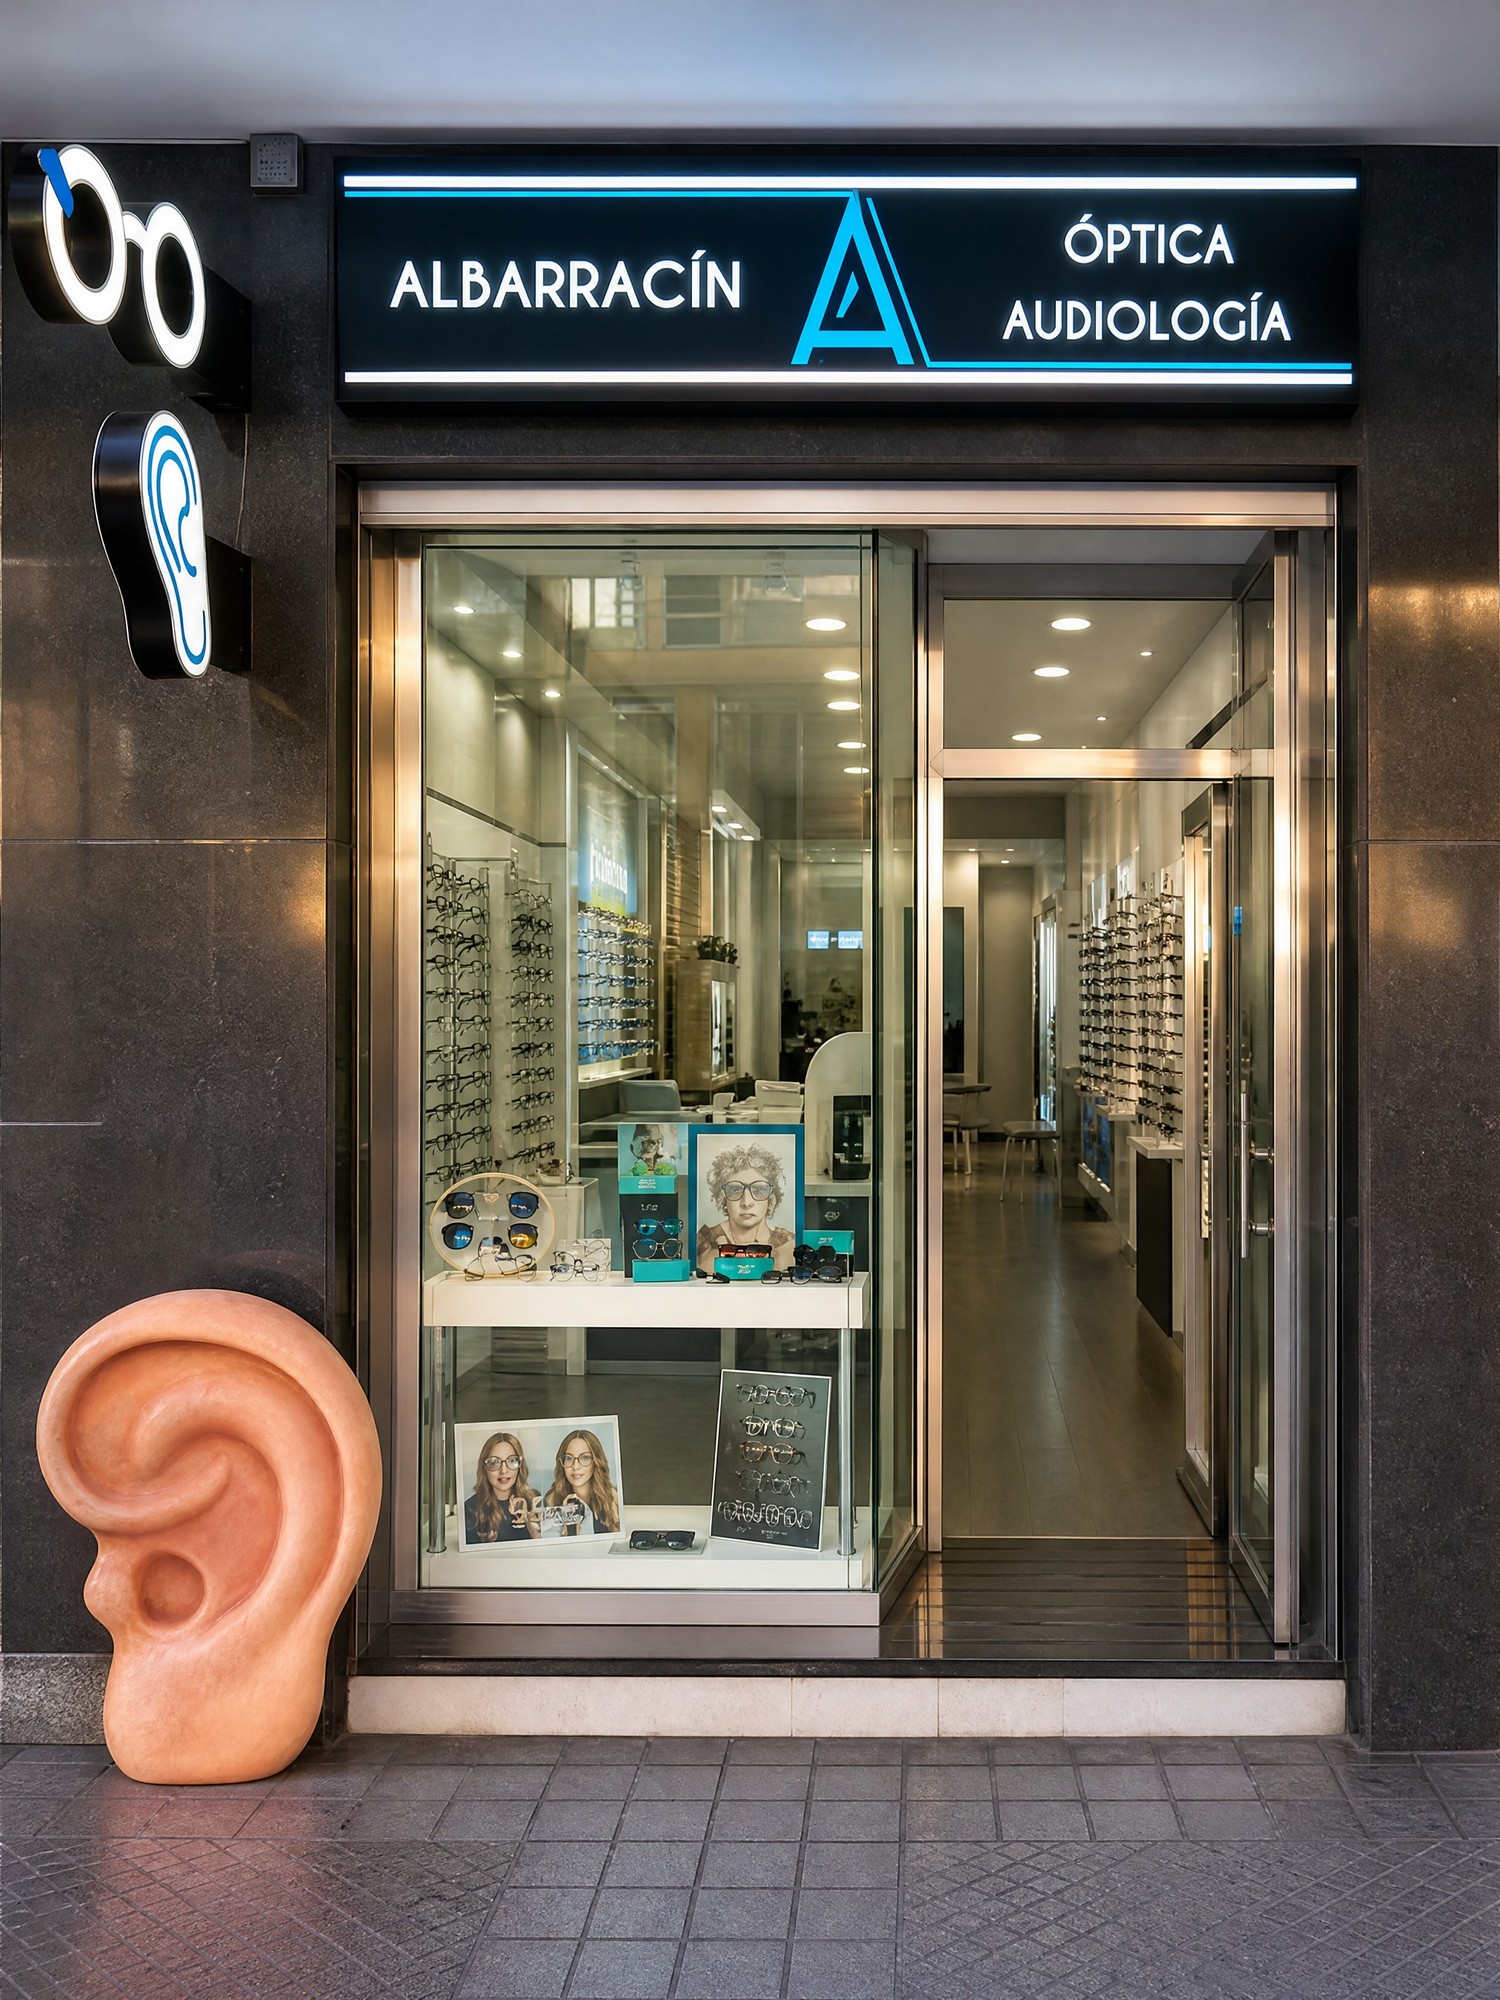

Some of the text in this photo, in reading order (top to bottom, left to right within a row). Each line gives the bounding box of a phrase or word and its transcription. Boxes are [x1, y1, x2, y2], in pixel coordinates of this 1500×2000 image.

[1063, 213, 1236, 266] ÓPTICA
[389, 249, 742, 310] ALBARRACÍN
[1002, 291, 1293, 343] AUDIOLOGÍA
